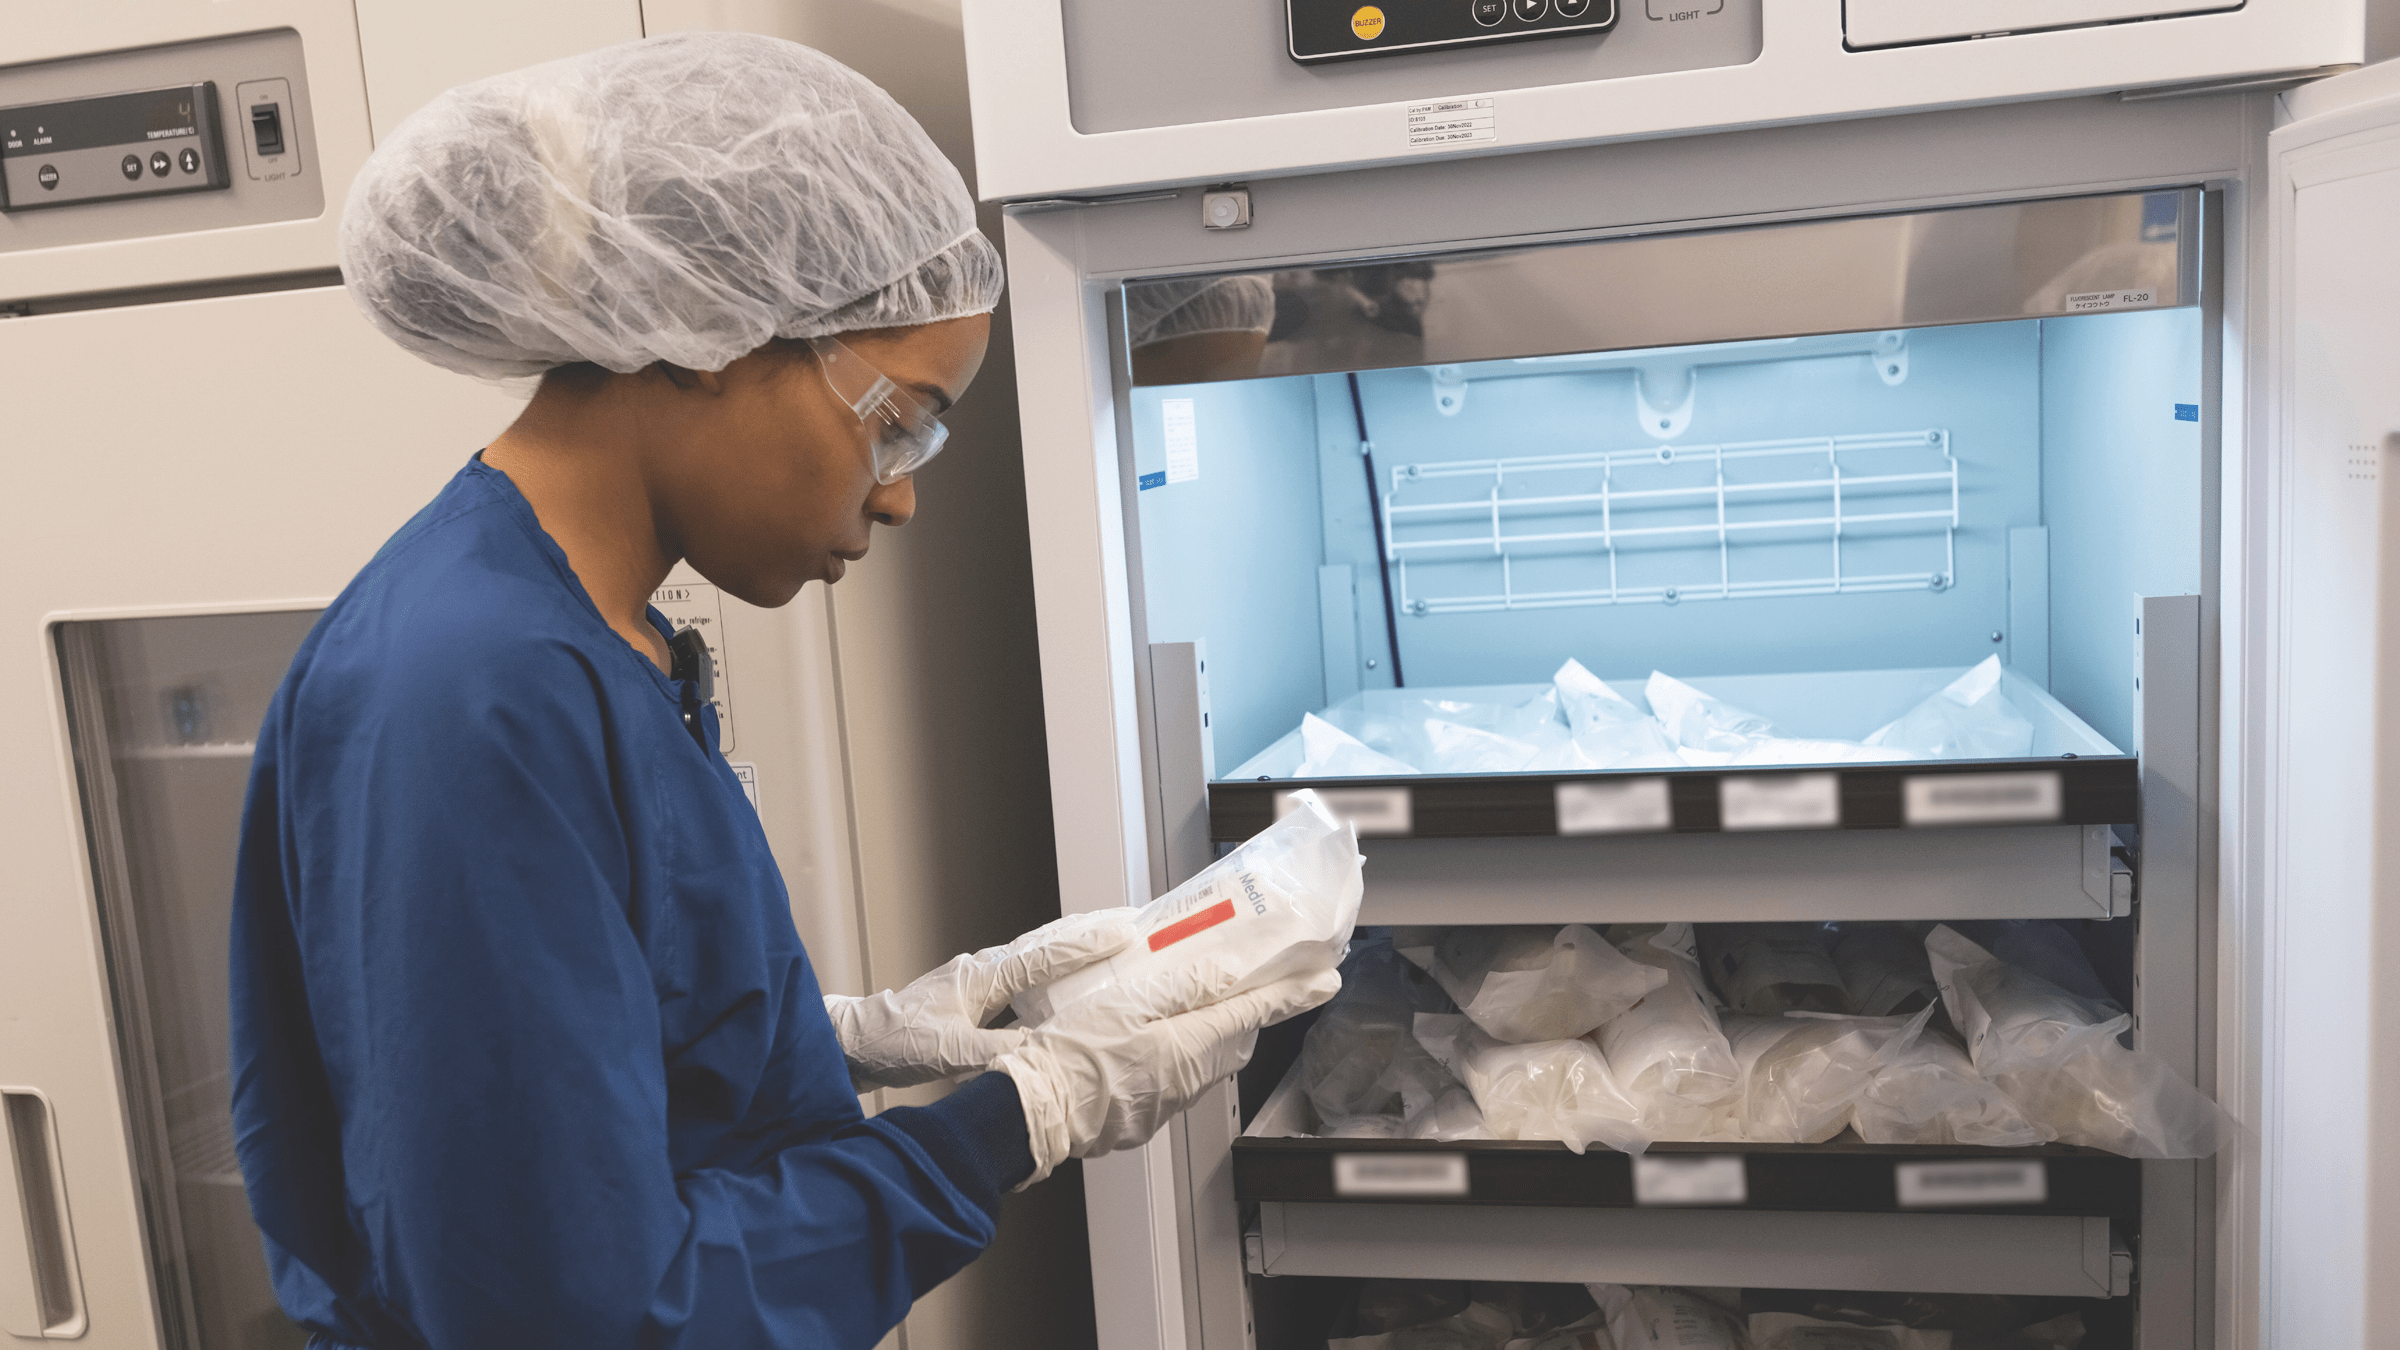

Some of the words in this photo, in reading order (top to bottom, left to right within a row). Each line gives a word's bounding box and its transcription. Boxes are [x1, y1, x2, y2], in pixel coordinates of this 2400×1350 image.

[1481, 4, 1497, 13] SET
[1669, 10, 1700, 22] LIGHT
[1355, 18, 1381, 27] BUZZER
[178, 102, 191, 122] 4
[1410, 125, 1434, 133] Calibration
[8, 140, 23, 148] DOOR
[33, 136, 53, 145] ALARM
[126, 163, 137, 172] SET
[40, 173, 58, 182] BUZZER
[264, 172, 286, 182] LIGHT
[2070, 294, 2100, 302] FLUORESCENT
[2123, 293, 2149, 302] FL-20
[2075, 301, 2110, 309] ケイコウトウ
[649, 588, 690, 601] TION>
[677, 617, 686, 625] the
[689, 615, 713, 625] refriger-
[1239, 872, 1267, 916] Media
